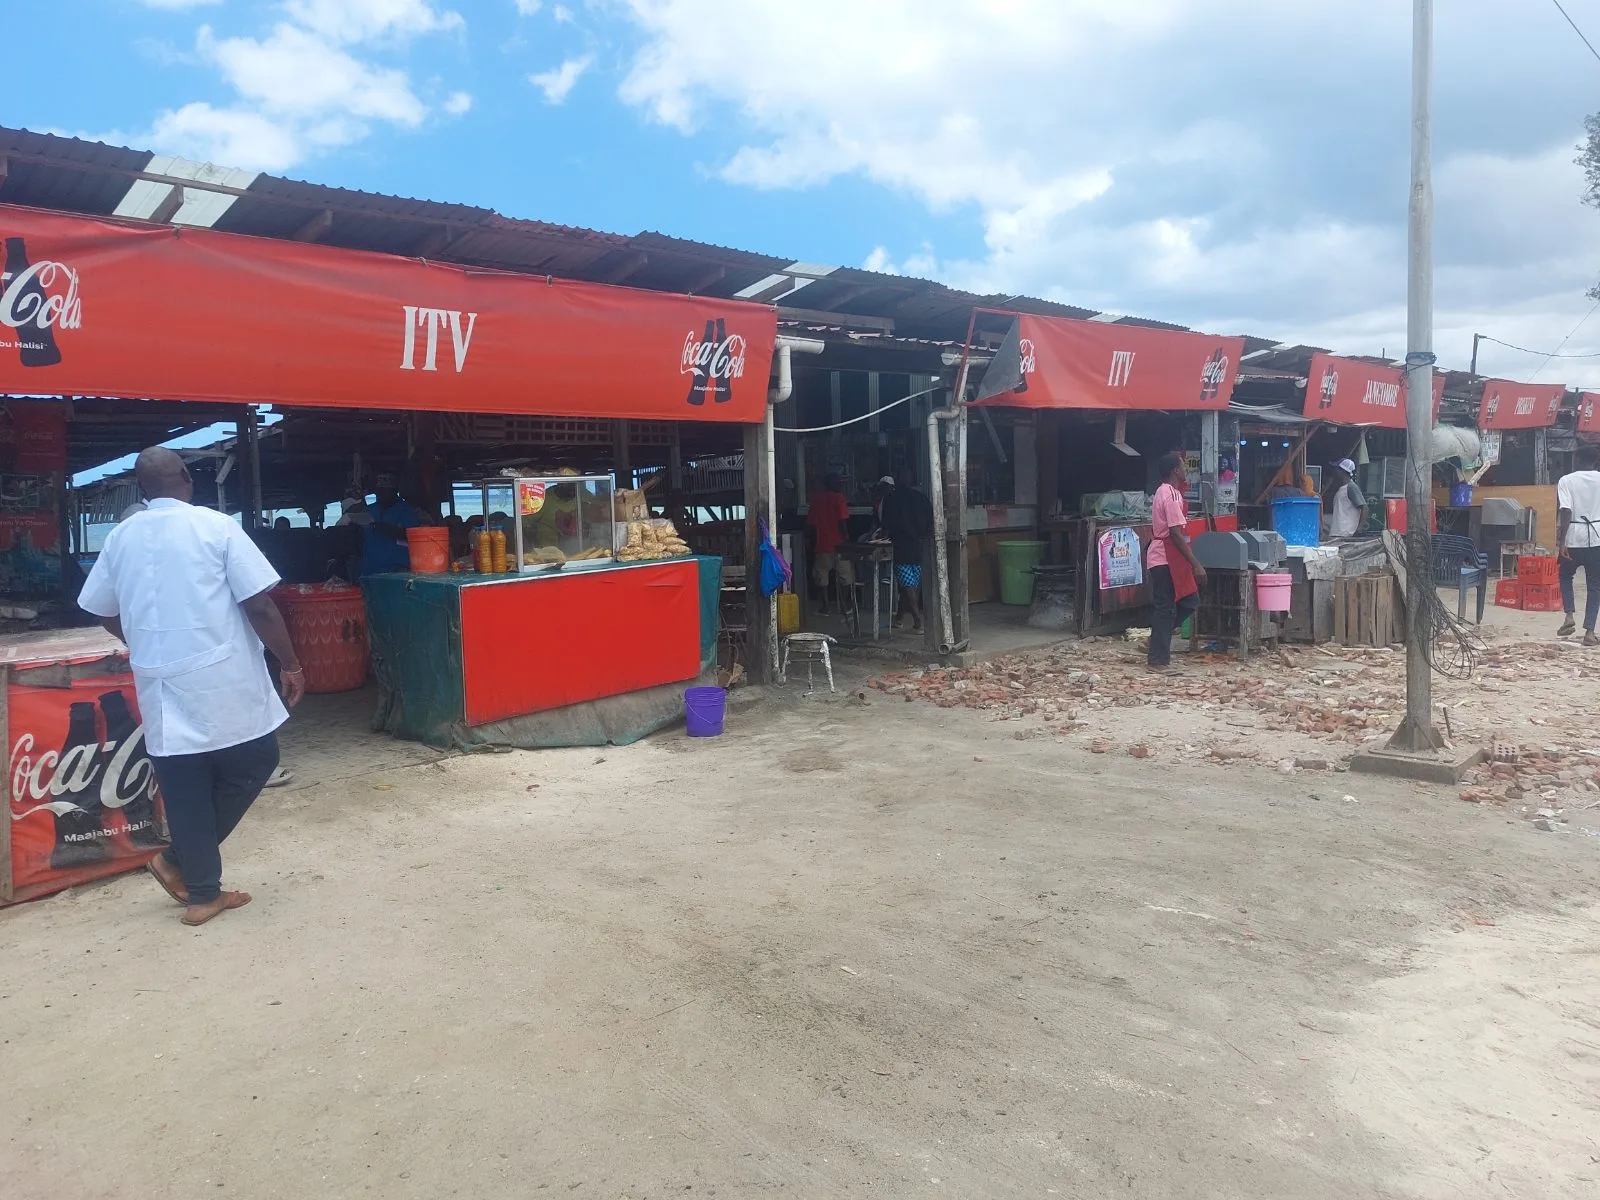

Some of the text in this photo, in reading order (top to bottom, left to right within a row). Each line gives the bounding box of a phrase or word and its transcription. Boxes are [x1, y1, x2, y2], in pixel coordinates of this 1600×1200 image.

[0, 260, 81, 329] -Cola
[15, 341, 45, 350] Halisi
[400, 305, 478, 373] ITV
[680, 330, 746, 379] Coca-Cola
[1107, 350, 1136, 387] ITV
[10, 723, 159, 820] Coca-C
[64, 827, 119, 843] Maajabu
